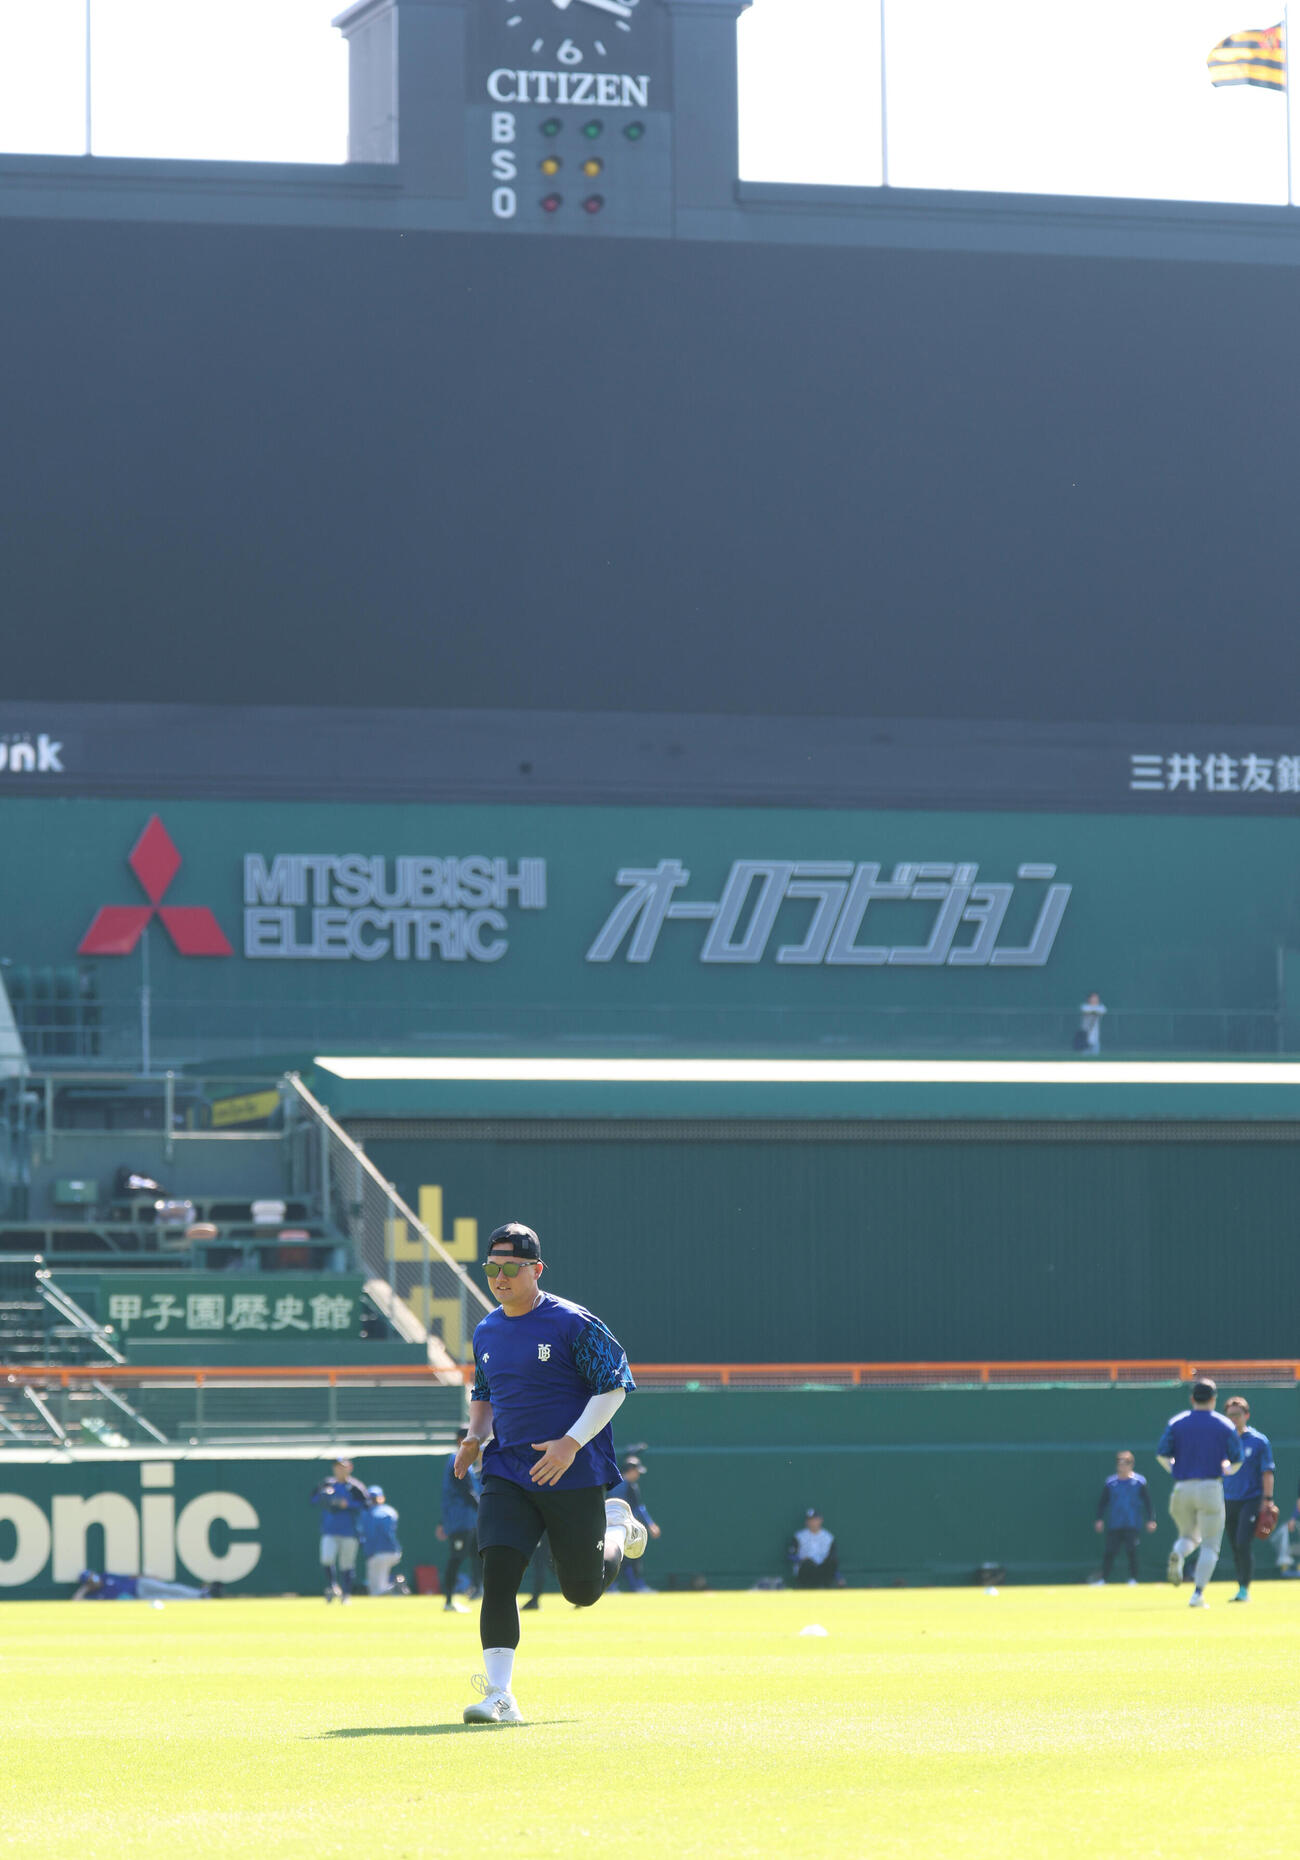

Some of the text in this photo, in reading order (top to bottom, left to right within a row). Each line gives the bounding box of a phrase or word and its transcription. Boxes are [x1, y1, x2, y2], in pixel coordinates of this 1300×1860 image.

[557, 39, 583, 65] 6
[487, 68, 649, 107] CITIZEN
[491, 111, 516, 143] B
[491, 149, 517, 181] S
[491, 186, 517, 219] O
[244, 853, 547, 909] MITSUBISHI
[586, 858, 1073, 966] オーロラビジョン
[244, 907, 508, 962] ELECTRIC
[109, 1294, 354, 1331] 甲子園歴史館
